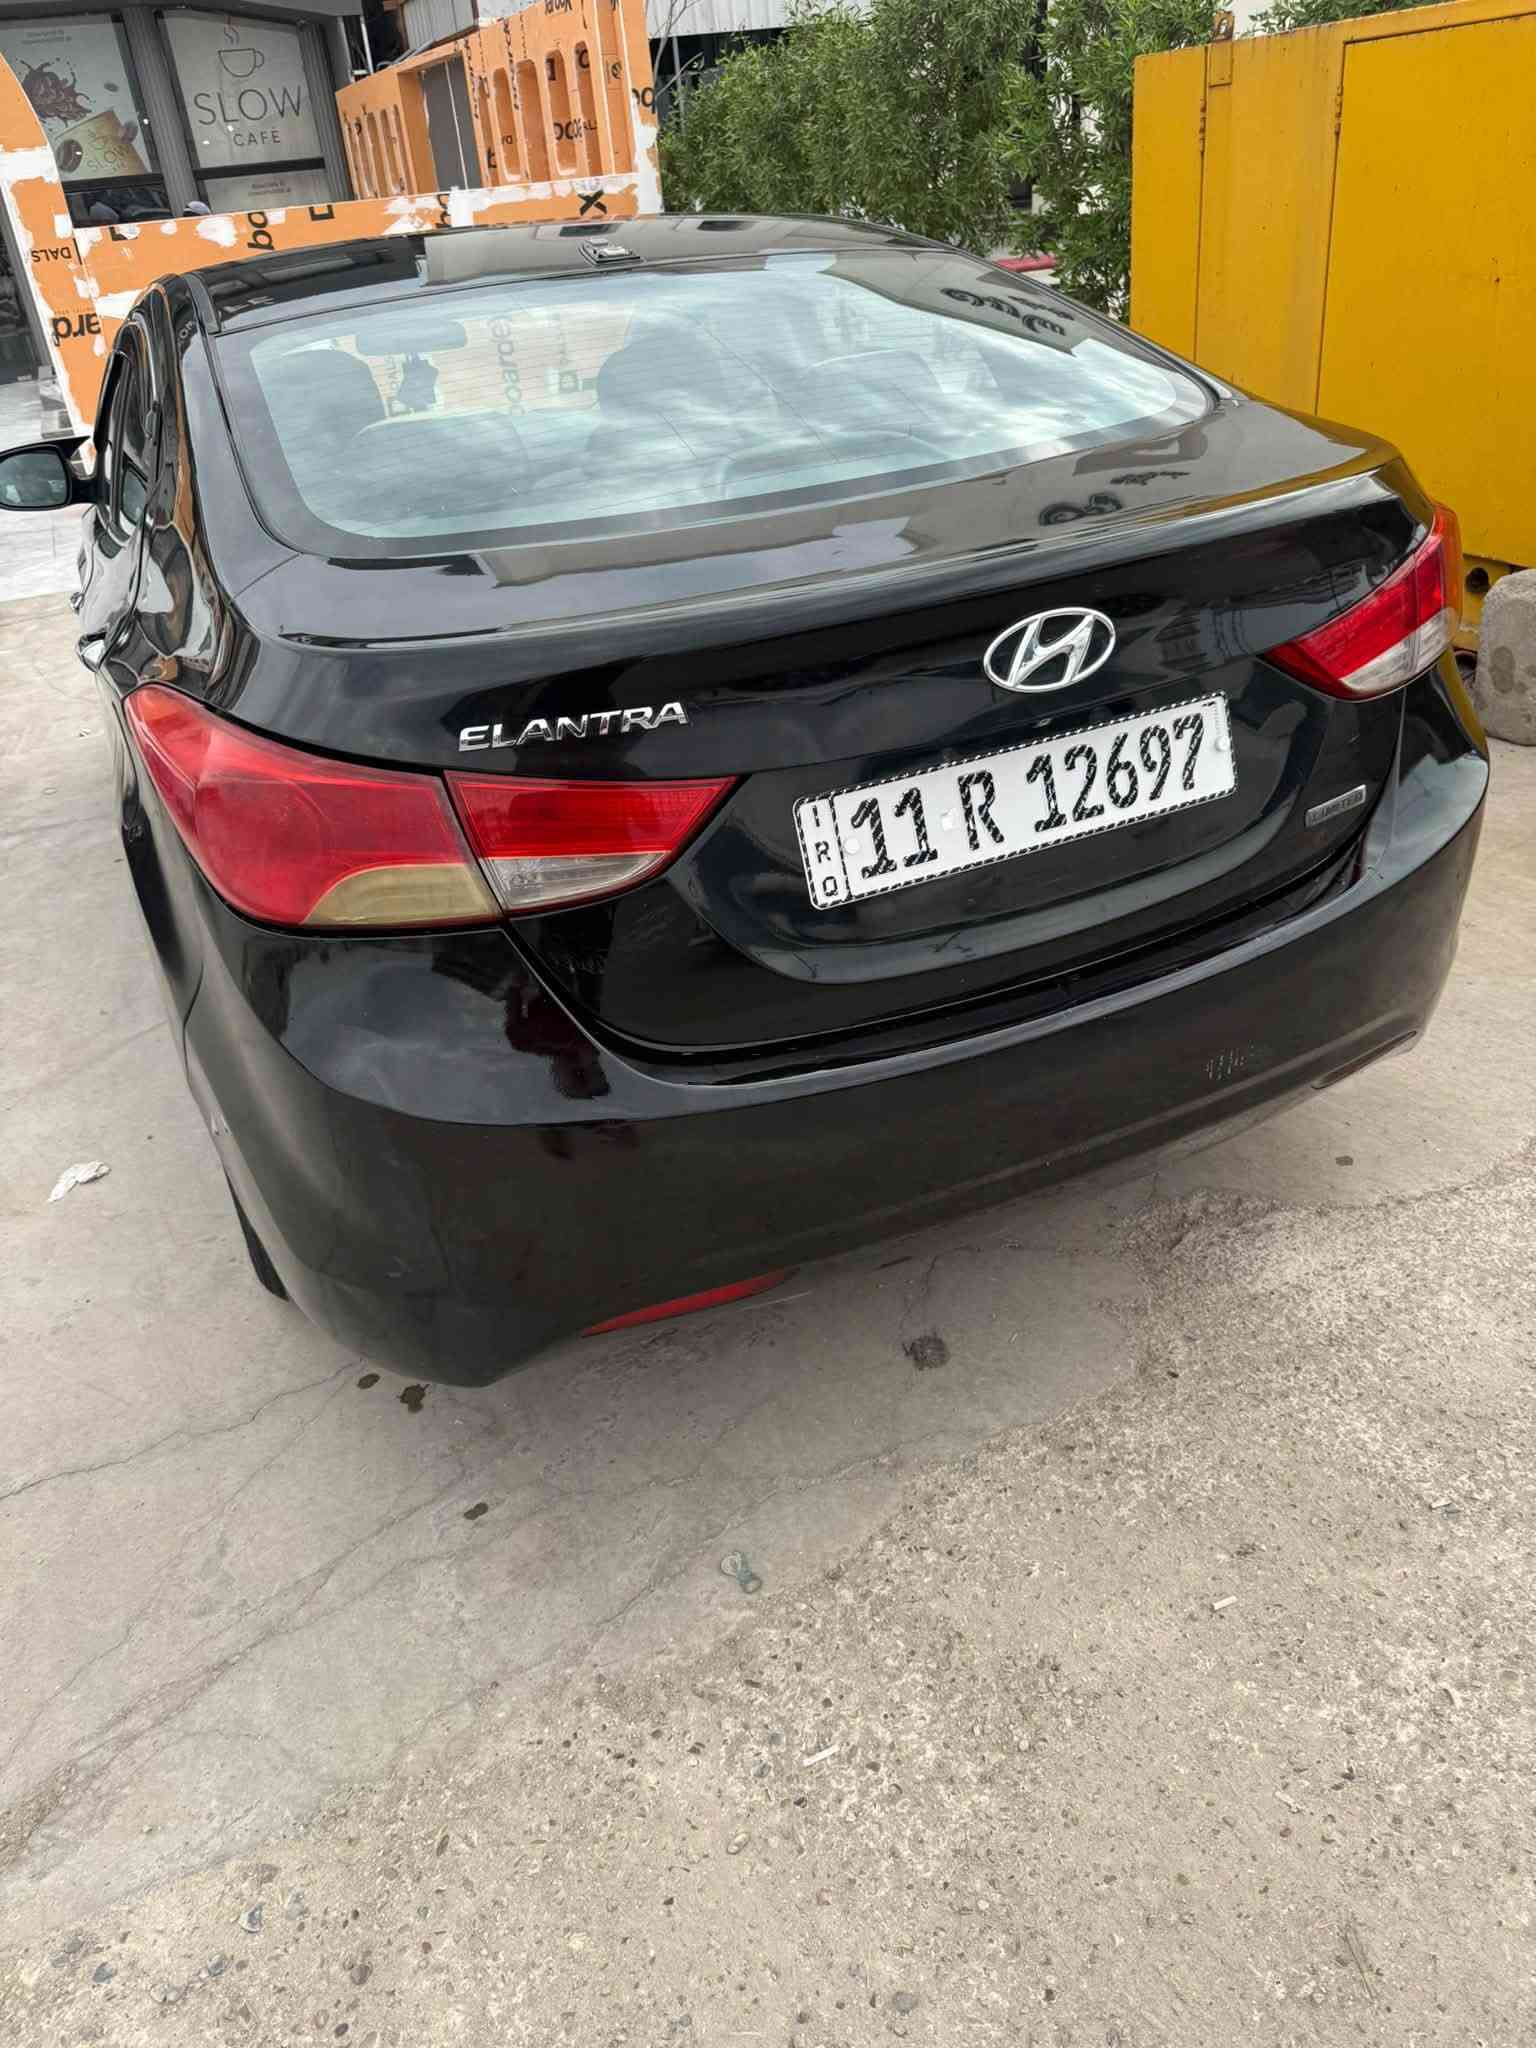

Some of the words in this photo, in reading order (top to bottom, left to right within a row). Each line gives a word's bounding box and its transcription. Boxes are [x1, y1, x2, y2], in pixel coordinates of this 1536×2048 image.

[193, 85, 302, 126] SLOW
[458, 701, 690, 752] ELANTRA
[850, 786, 939, 879] 11
[957, 768, 1005, 852] R
[1026, 712, 1204, 833] 12697
